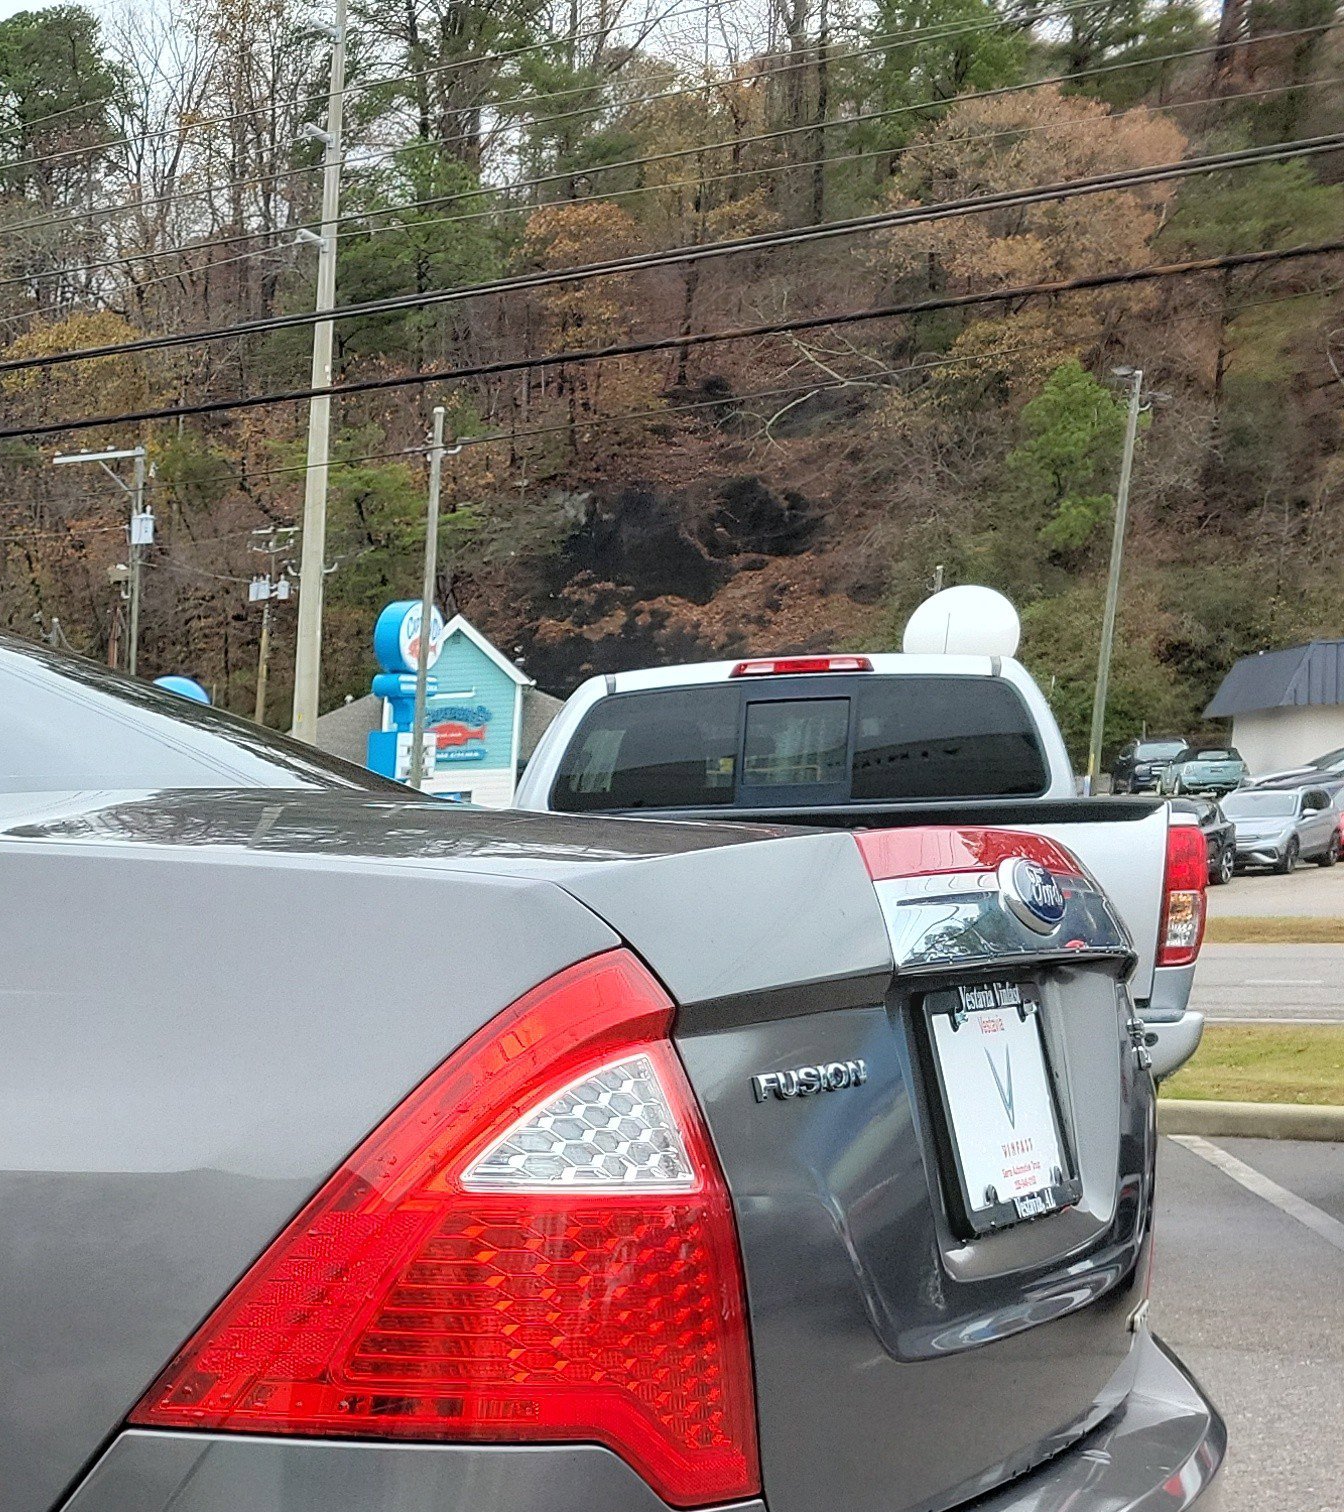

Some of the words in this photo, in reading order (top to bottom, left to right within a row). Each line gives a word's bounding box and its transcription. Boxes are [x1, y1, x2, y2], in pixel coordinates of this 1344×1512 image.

[1025, 864, 1063, 906] Ford
[958, 984, 995, 1011] Vestavia
[751, 1059, 867, 1103] FUSION
